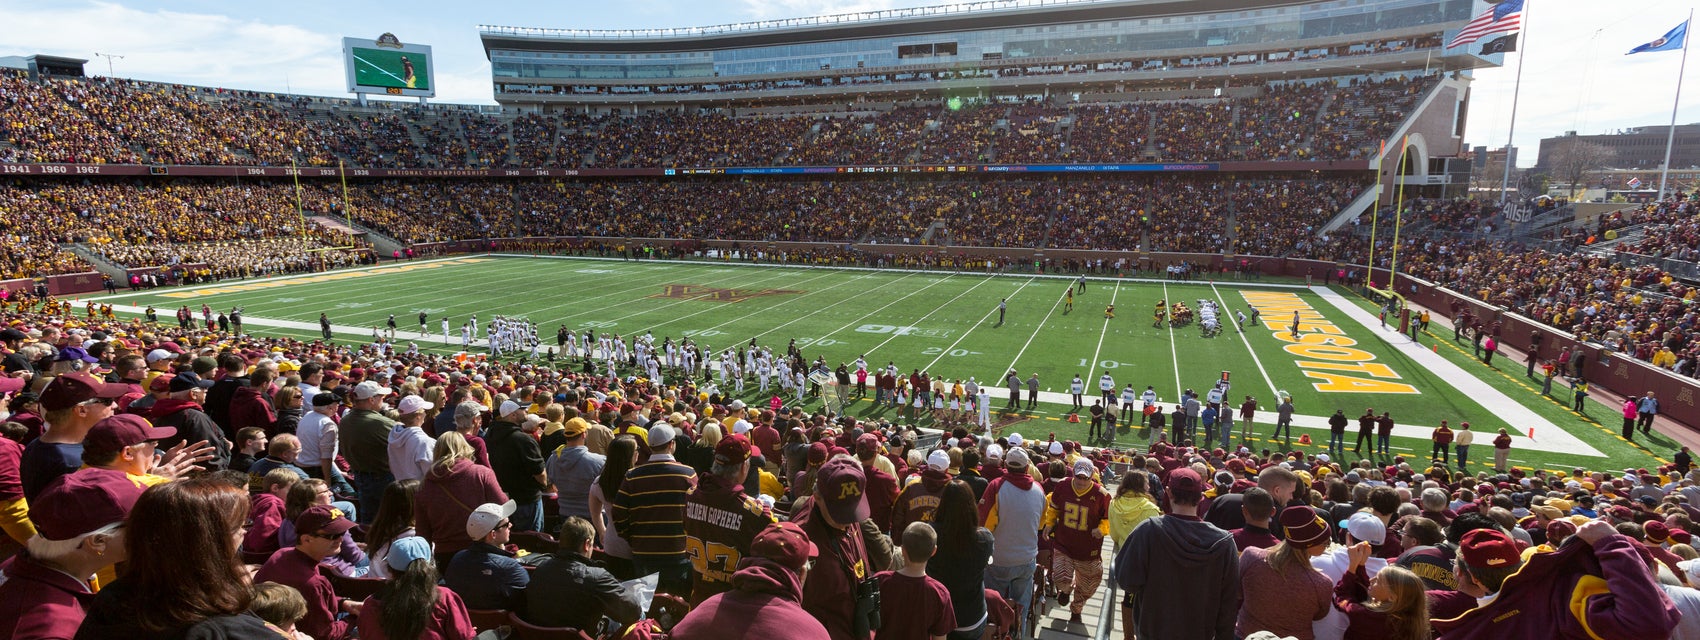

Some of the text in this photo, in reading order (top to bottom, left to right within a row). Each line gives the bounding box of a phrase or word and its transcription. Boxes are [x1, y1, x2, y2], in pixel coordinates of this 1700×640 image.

[3, 165, 100, 174] 1941 1960 1967
[921, 346, 969, 357] 20
[1076, 358, 1119, 369] 10
[838, 481, 861, 499] M
[708, 506, 743, 531] GOPHERS
[1063, 501, 1089, 531] 21
